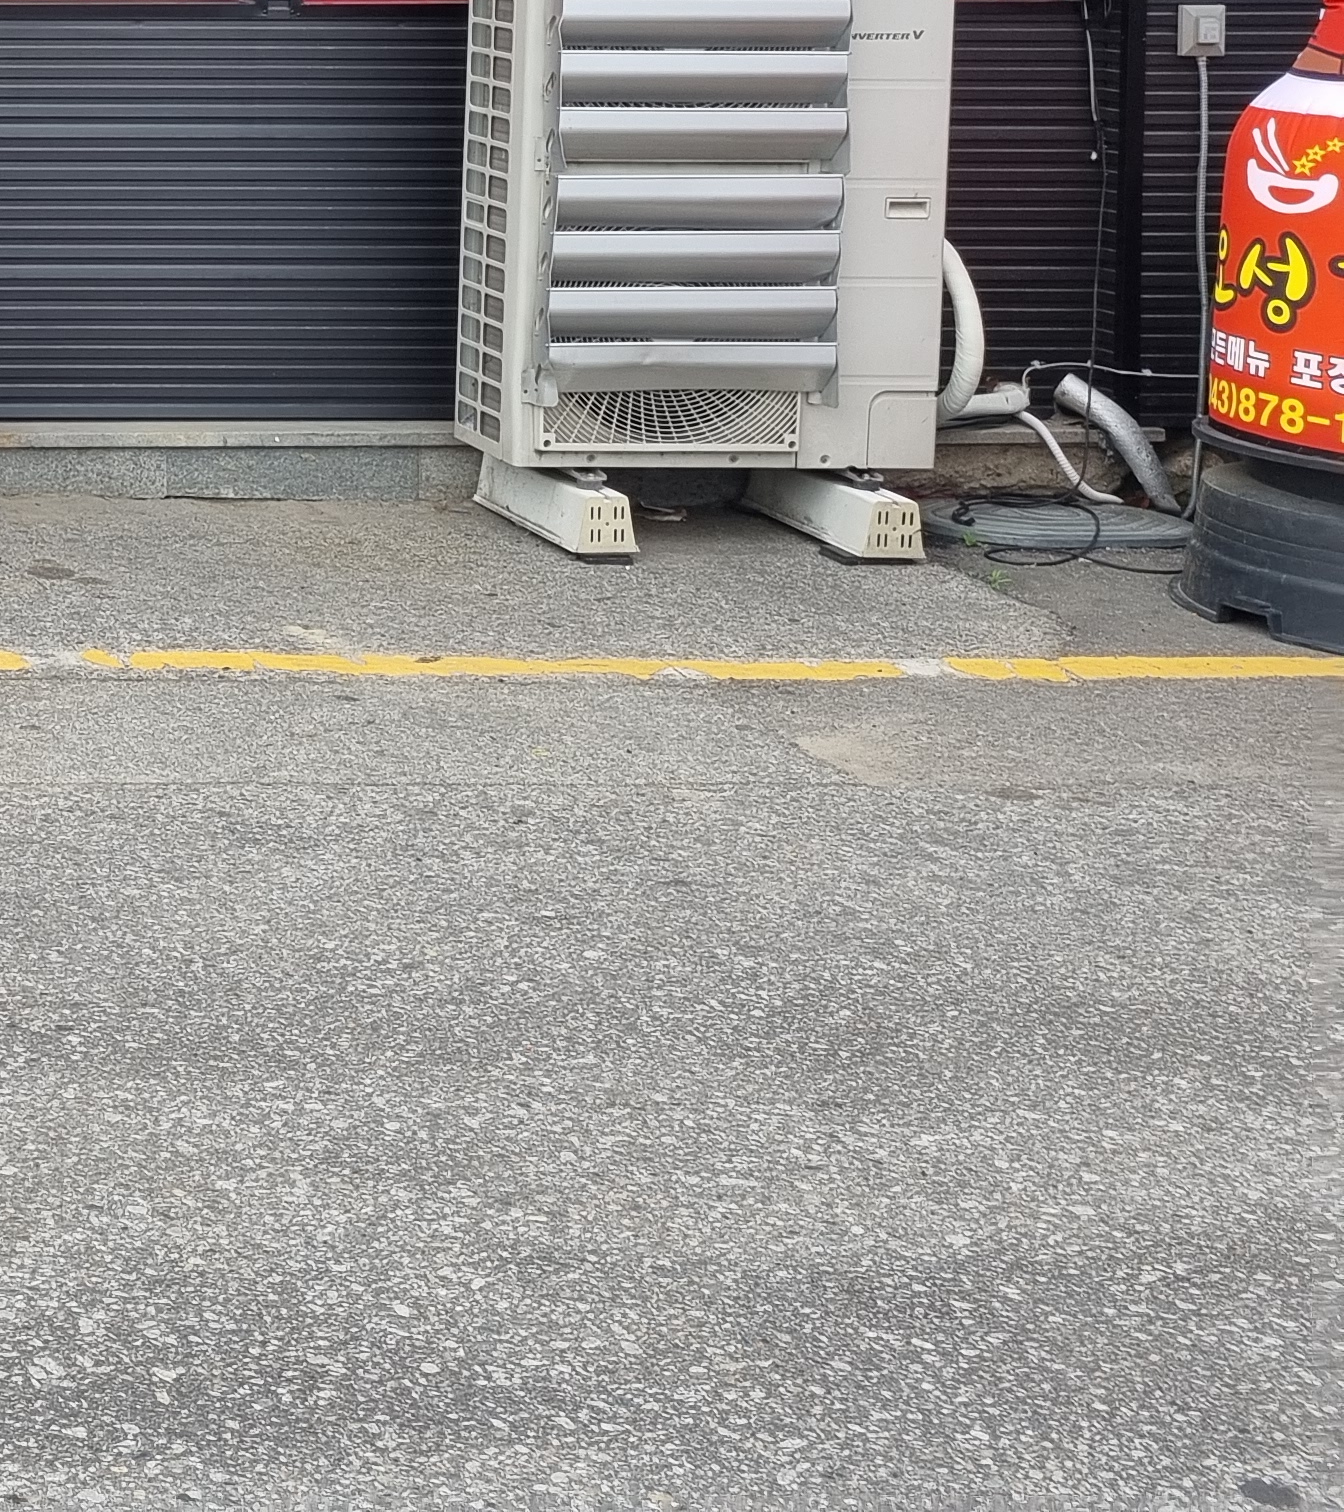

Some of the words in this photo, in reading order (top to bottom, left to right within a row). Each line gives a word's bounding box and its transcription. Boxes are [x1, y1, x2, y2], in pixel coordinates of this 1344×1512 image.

[851, 32, 910, 41] NVERTER
[1214, 229, 1344, 326] 오성
[1211, 328, 1271, 378] 든메뉴
[1209, 372, 1344, 444] 43)878-1
